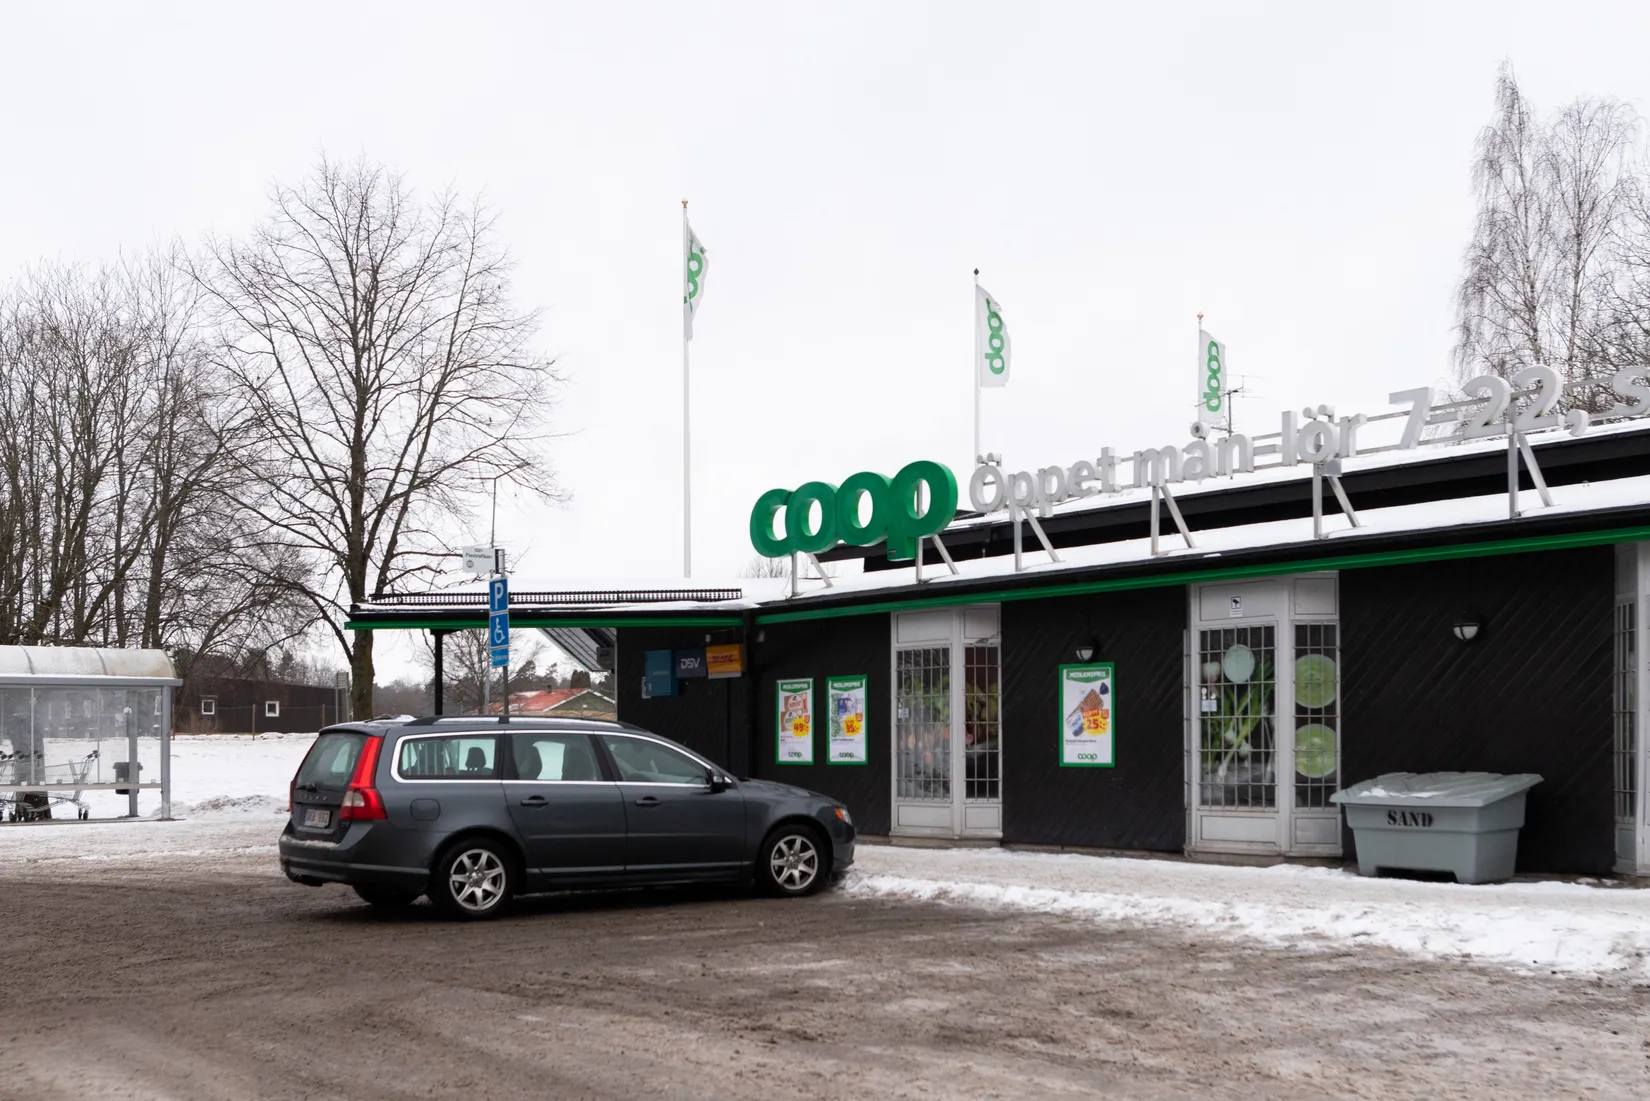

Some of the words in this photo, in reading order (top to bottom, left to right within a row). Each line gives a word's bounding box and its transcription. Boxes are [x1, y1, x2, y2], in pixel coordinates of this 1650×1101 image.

[1203, 340, 1222, 412] coop
[969, 452, 1121, 522] Öppet
[750, 460, 959, 561] coop
[494, 582, 504, 610] P
[680, 657, 701, 670] DSV
[788, 751, 802, 759] coop
[839, 751, 855, 759] coop
[1387, 809, 1434, 828] SAND
